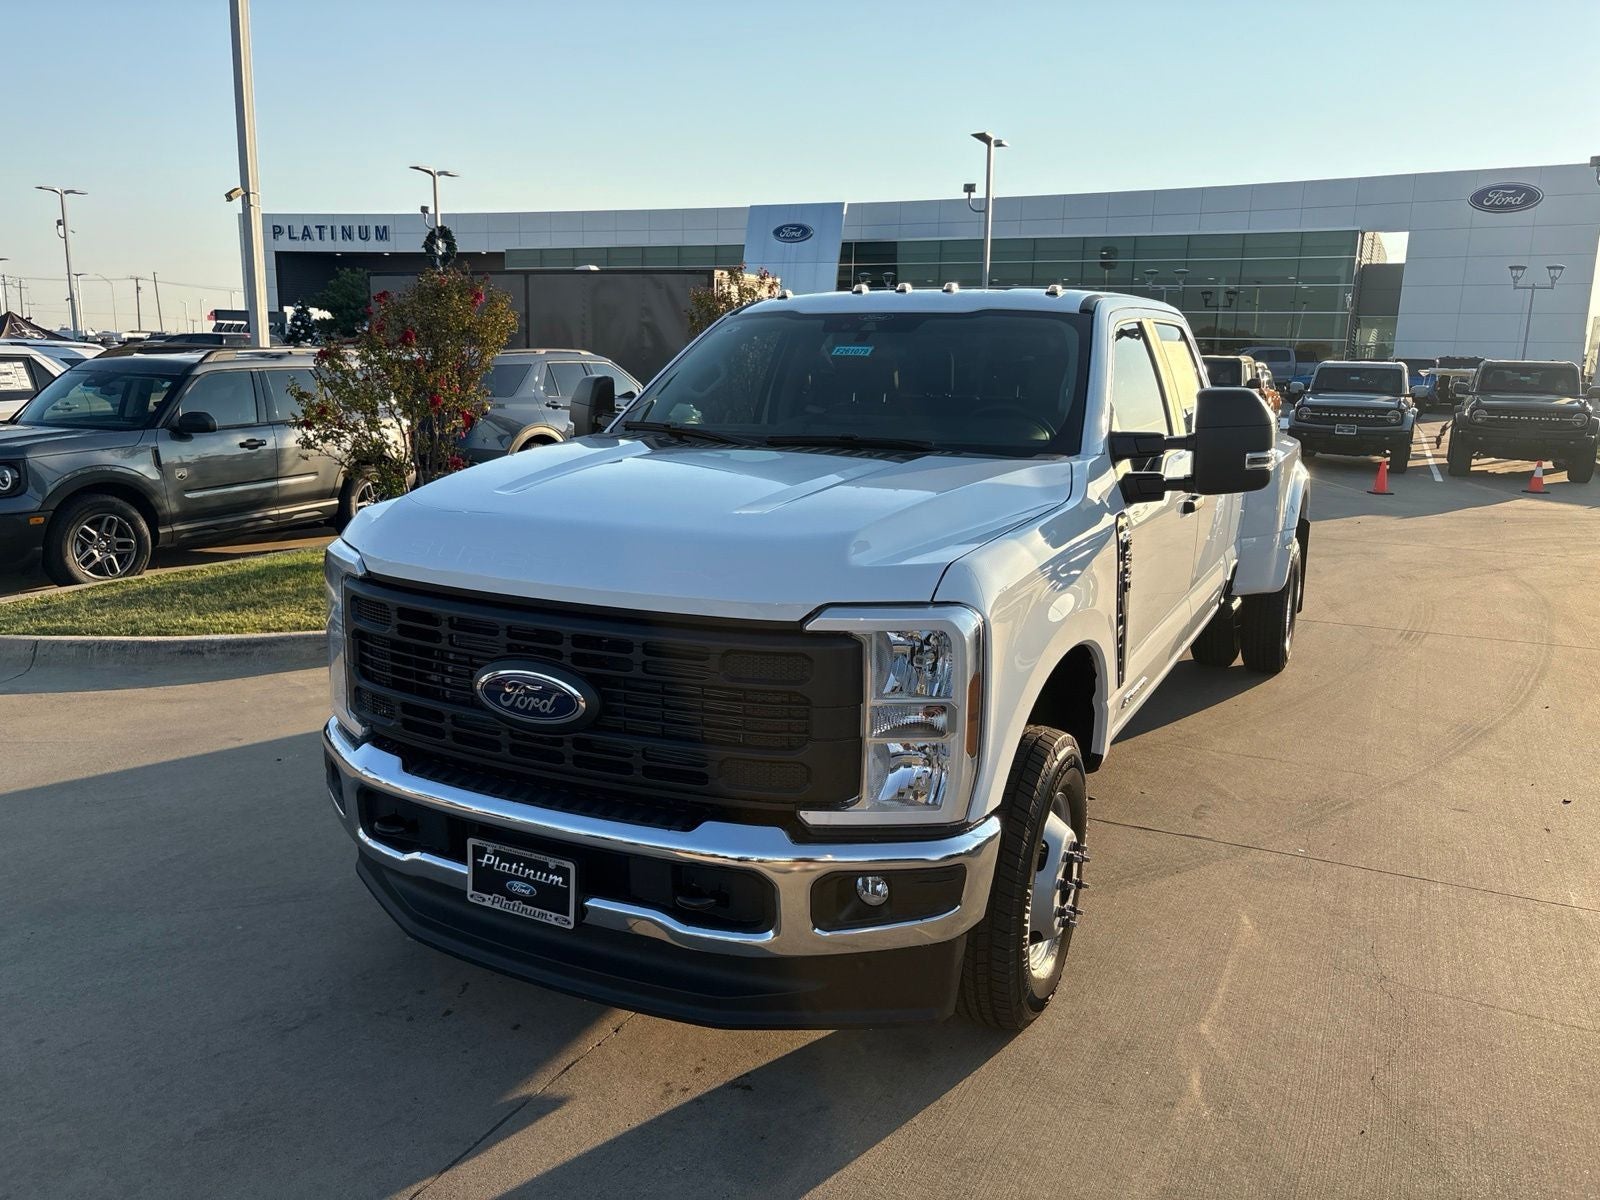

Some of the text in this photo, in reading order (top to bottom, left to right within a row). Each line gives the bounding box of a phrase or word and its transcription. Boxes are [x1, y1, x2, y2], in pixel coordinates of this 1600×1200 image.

[272, 225, 389, 241] PLATINUM
[835, 347, 869, 355] F261079
[500, 680, 558, 713] Ford
[477, 854, 568, 888] Platinum
[491, 894, 551, 920] Platinum
